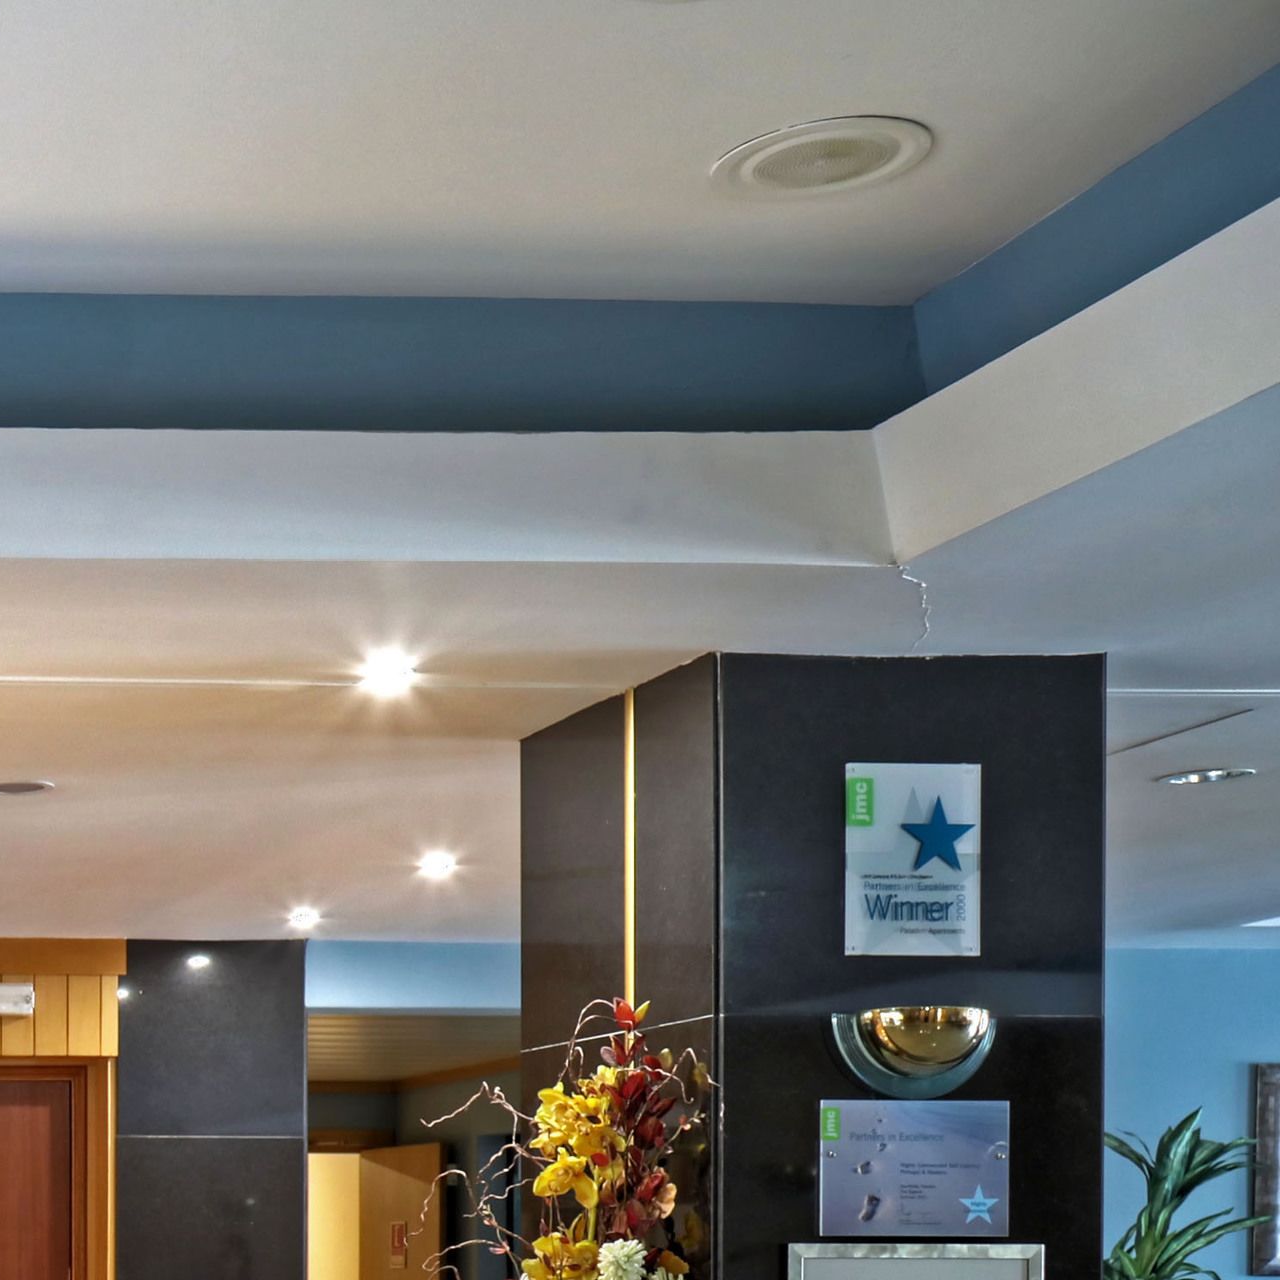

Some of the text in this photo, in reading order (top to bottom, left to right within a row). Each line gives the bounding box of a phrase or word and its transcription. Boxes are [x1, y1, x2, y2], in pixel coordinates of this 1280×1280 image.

[852, 781, 870, 822] jmc
[864, 893, 954, 921] Winner
[850, 1132, 884, 1141] Partners
[899, 1131, 945, 1141] Excellence
